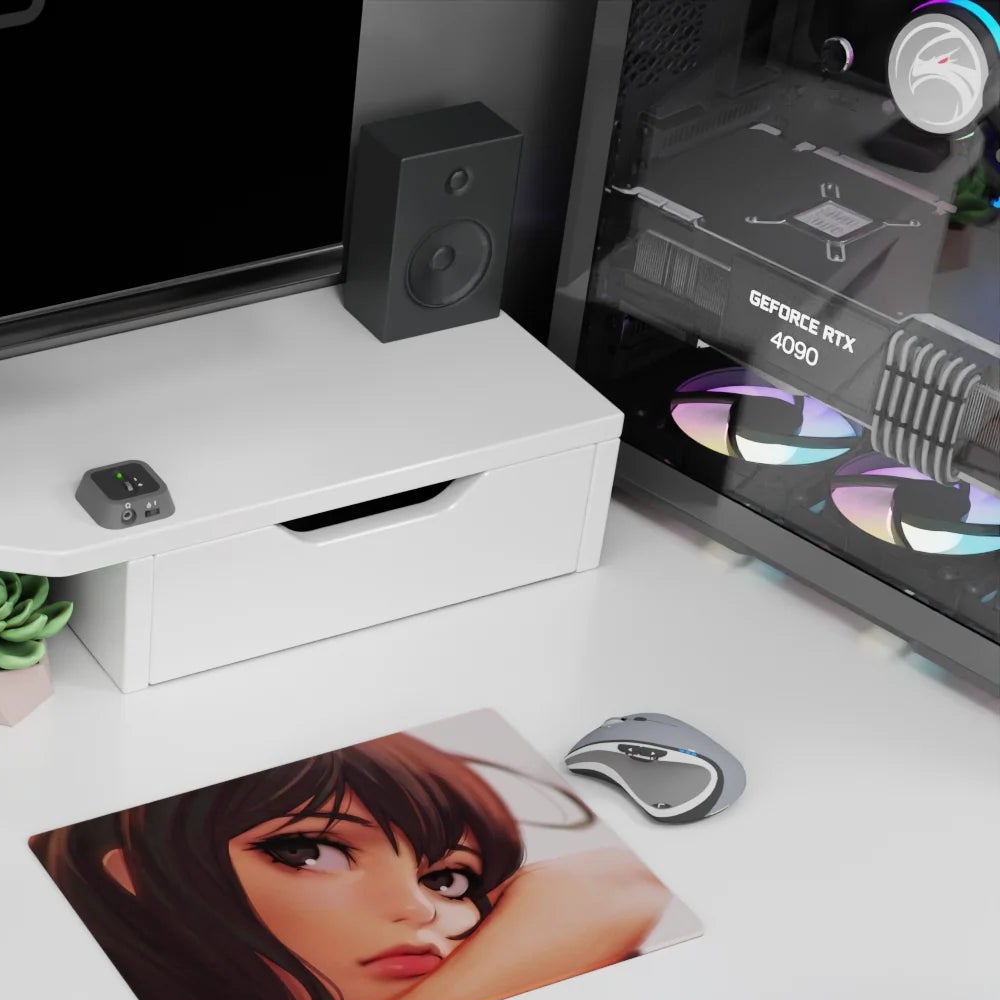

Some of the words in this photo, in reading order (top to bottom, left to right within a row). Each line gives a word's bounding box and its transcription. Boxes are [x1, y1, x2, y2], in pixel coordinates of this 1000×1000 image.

[749, 289, 821, 336] GEFORCE
[822, 324, 857, 354] RTX
[770, 331, 819, 367] 4090
